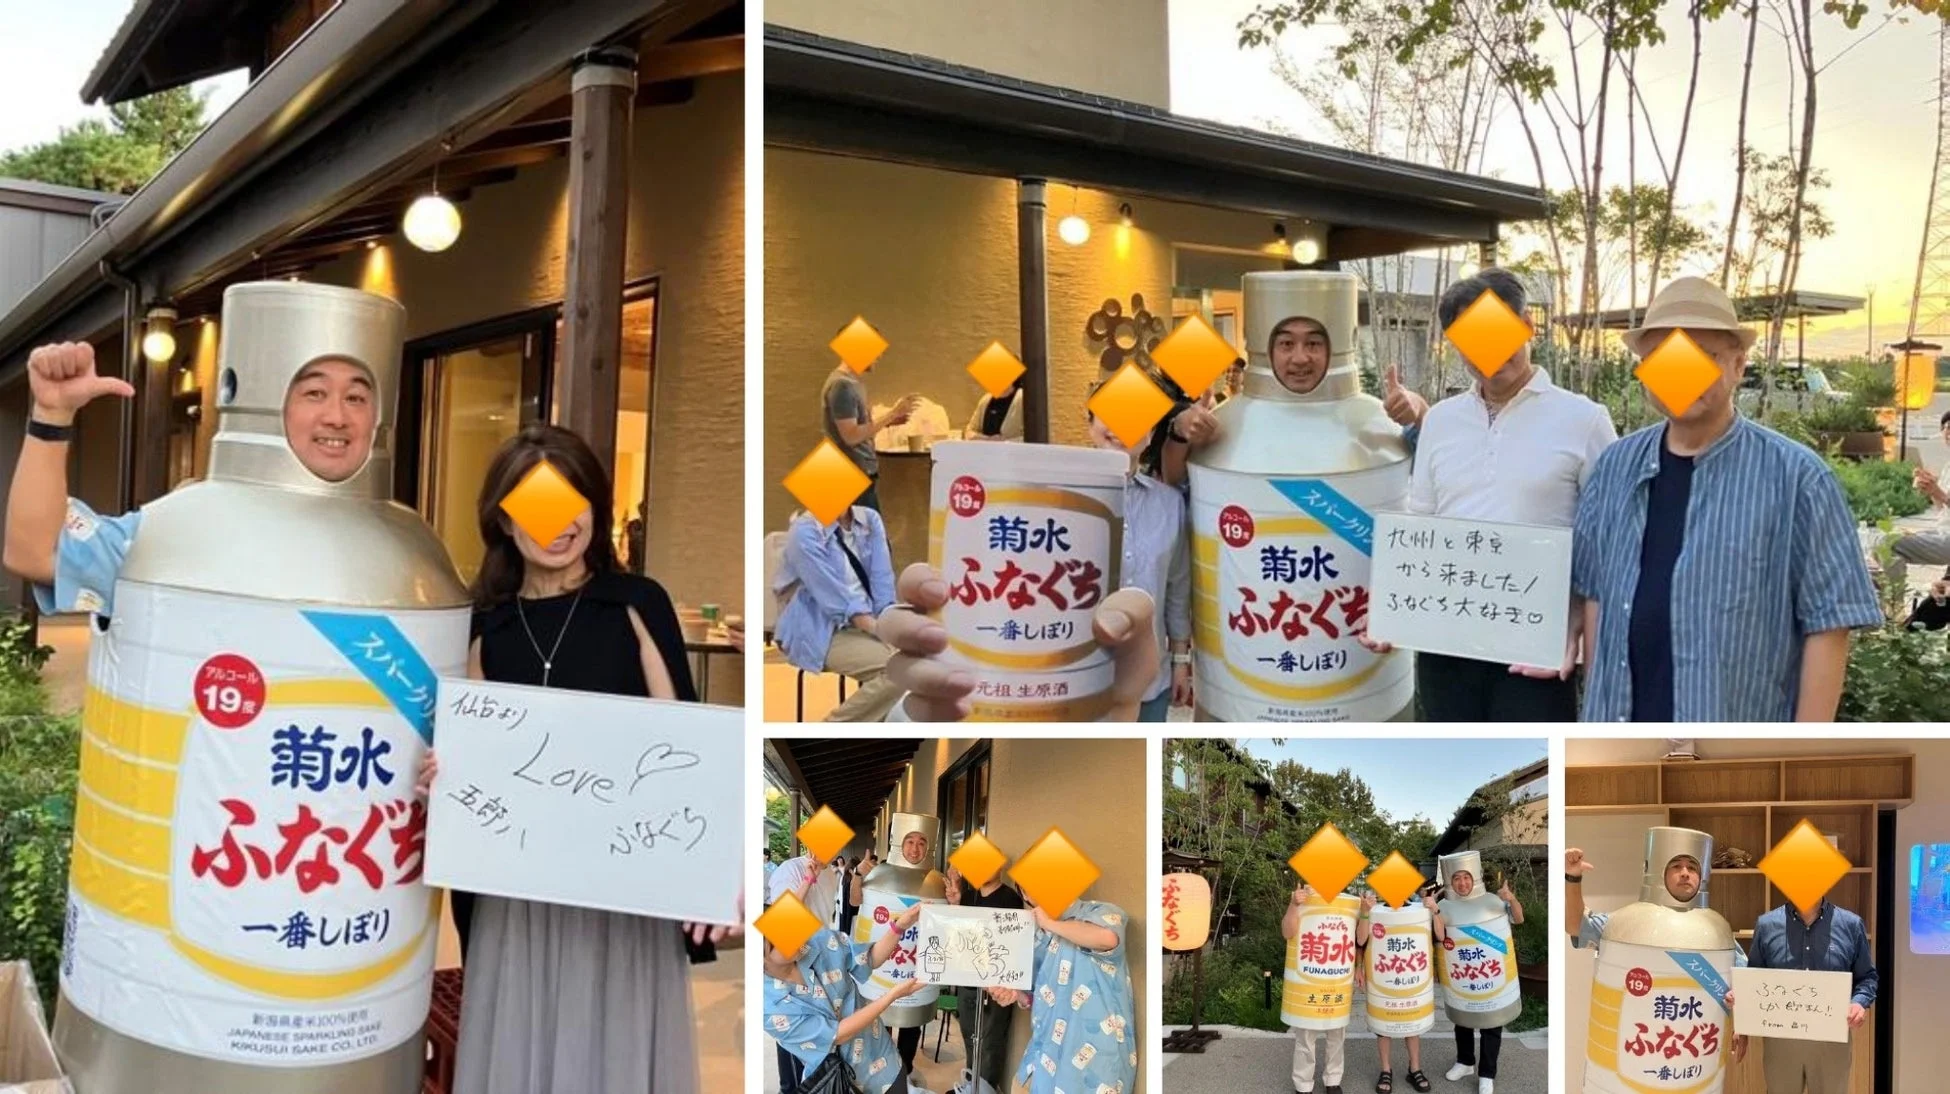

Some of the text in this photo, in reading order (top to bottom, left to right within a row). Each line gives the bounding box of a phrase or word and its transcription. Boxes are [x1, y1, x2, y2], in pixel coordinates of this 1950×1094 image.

[988, 515, 1071, 553] 菊水
[1261, 545, 1339, 583] 菊水
[949, 557, 1102, 611] ふなぐち
[976, 619, 1074, 641] 一番しぼり
[1256, 650, 1347, 673] 一番しぼり
[352, 631, 436, 728] スパークリ
[271, 725, 395, 792] 菊水
[512, 732, 617, 804] Love
[190, 798, 426, 893] ふなぐち
[609, 806, 708, 856] ふなぐち
[1161, 878, 1181, 941] ふなぐち
[1317, 920, 1349, 932] ふなぐち
[240, 910, 390, 950] 一番しぼり
[1387, 936, 1416, 953] 菊水
[1300, 931, 1354, 965] 菊水
[1374, 951, 1427, 974] ふなぐち
[1458, 947, 1486, 962] 菊水
[1385, 975, 1420, 986] 一番しぼり
[1450, 959, 1502, 981] ふなぐち
[1462, 981, 1494, 991] 一番しぼり
[1654, 994, 1704, 1021] 菊水
[1624, 1022, 1720, 1060] ふなぐち
[1643, 1064, 1702, 1081] 一番しぼり
